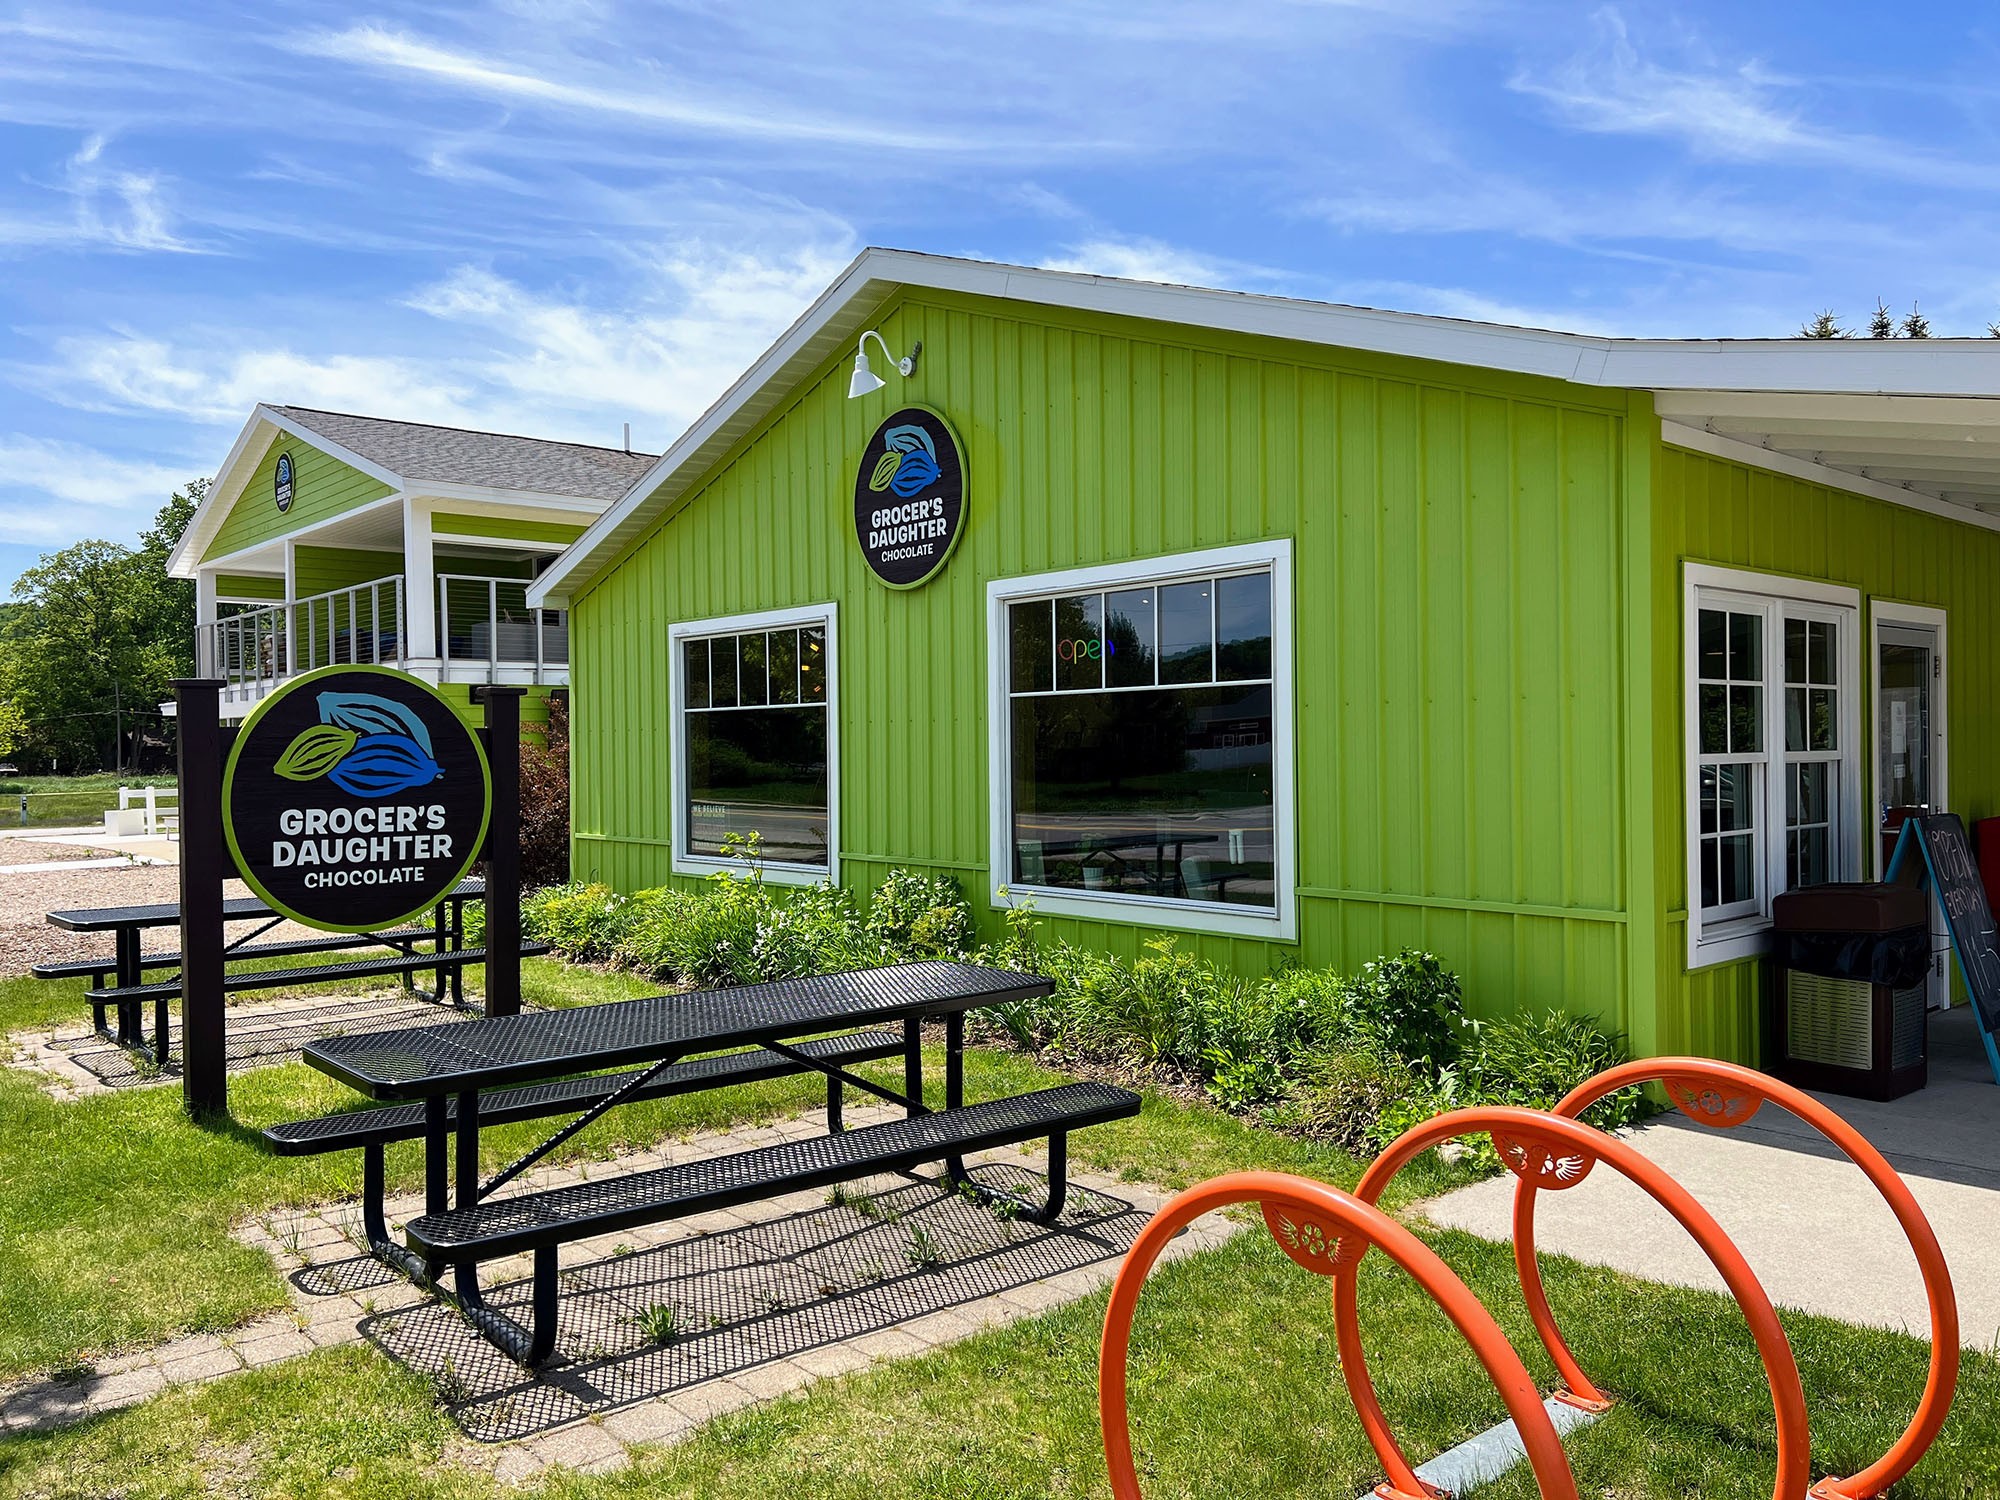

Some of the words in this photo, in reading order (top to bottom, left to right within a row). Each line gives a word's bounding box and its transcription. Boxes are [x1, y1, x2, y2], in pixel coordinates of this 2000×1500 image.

[871, 497, 943, 528] GROCER'S
[869, 518, 947, 549] DAUGHTER
[881, 543, 934, 563] CHOCOLATE
[280, 804, 446, 836] GROCER'S
[273, 834, 453, 867] DAUGHTER
[1931, 829, 1974, 881] OPEN
[304, 866, 425, 889] CHOCOLATE
